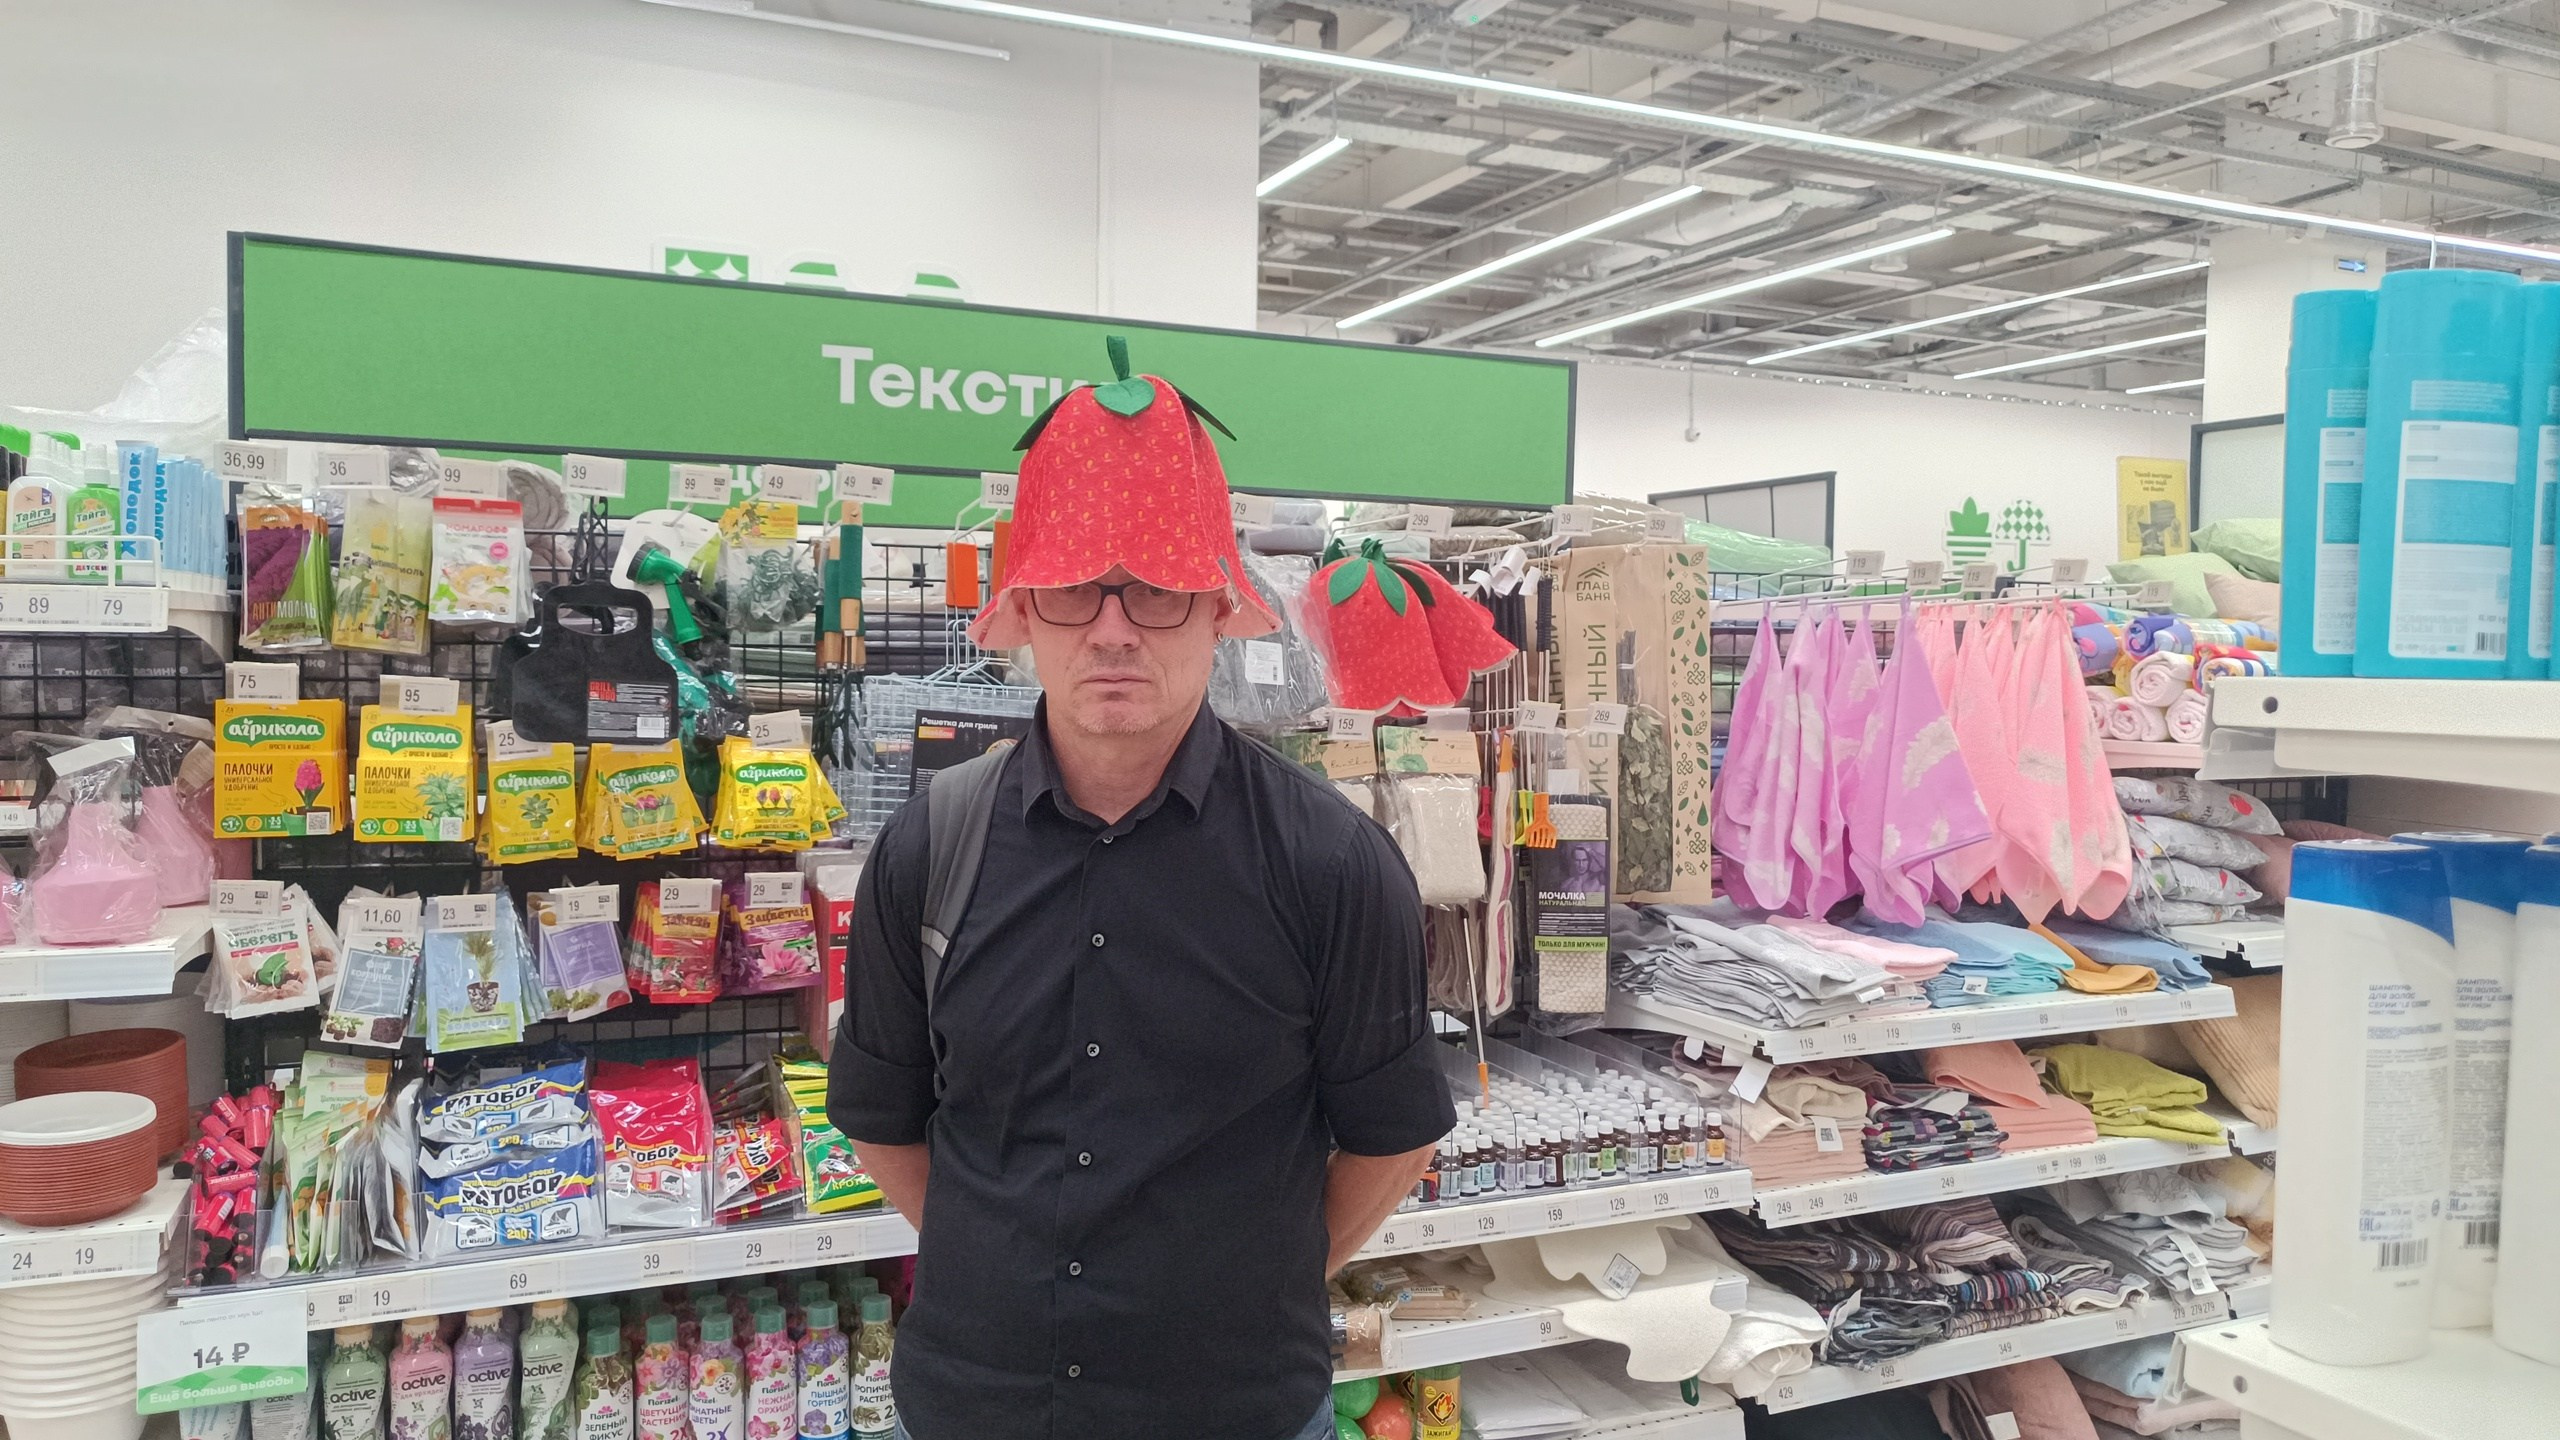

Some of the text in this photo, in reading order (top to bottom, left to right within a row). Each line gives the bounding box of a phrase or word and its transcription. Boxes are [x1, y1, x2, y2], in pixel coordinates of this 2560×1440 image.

[822, 343, 1118, 417] Тексти
[223, 450, 265, 470] 36,99
[329, 461, 347, 475] 36
[571, 464, 587, 480] 39
[444, 467, 461, 483] 99
[844, 475, 856, 488] 49
[684, 478, 696, 490] 99
[768, 476, 784, 489] 49
[989, 483, 1009, 497] 199
[122, 452, 142, 557] ХОЛОДОК
[1234, 502, 1246, 515] 79
[16, 508, 51, 523] Тайга
[76, 509, 107, 523] Тайга
[155, 463, 167, 563] ОЛОДОК
[1561, 513, 1571, 525] 39
[1412, 514, 1429, 526] 299
[1650, 519, 1666, 531] 359
[1852, 558, 1866, 568] 119
[1913, 568, 1926, 580] 119
[1967, 571, 1980, 582] 119
[2058, 566, 2071, 576] 119
[1576, 581, 1610, 591] ГЛАВ
[2147, 587, 2159, 597] 119
[1576, 593, 1610, 601] БАНЯ
[28, 597, 49, 614] 89
[103, 599, 123, 615] 79
[239, 675, 256, 689] 75
[405, 689, 420, 702] 95
[1524, 710, 1536, 721] 79
[1594, 711, 1610, 721] 269
[229, 717, 322, 741] агрикола
[921, 717, 998, 731] Решетка для гриля
[1338, 718, 1354, 730] 159
[371, 725, 458, 748] агрикола
[755, 724, 769, 738] 25
[499, 733, 515, 746] 25
[224, 763, 273, 776] ПАЛОЧКИ
[364, 766, 411, 779] ПАЛОЧКИ
[740, 765, 804, 782] агрикола
[224, 776, 272, 784] УНИВЕРСАЛЬНОЕ
[497, 773, 569, 791] агрикола
[609, 768, 677, 790] агрикола
[364, 787, 396, 795] УДОБРЕНИЕ
[3, 813, 18, 822] 149
[664, 887, 679, 900] 29
[753, 884, 765, 896] 29
[1538, 891, 1586, 900] МОЧАЛКА
[220, 892, 234, 904] 29
[568, 900, 580, 911] 19
[364, 909, 401, 924] 11,60
[443, 908, 456, 920] 23
[2115, 1006, 2128, 1017] 119
[2180, 1000, 2192, 1010] 119
[2039, 1013, 2048, 1025] 89
[1886, 1027, 1900, 1039] 119
[1952, 1022, 1961, 1033] 99
[1800, 1037, 1814, 1049] 119
[1843, 1032, 1857, 1044] 119
[445, 1081, 543, 1113] РАТОБОР
[614, 1136, 679, 1162] РТОБОР
[2069, 1157, 2082, 1168] 199
[2094, 1153, 2107, 1165] 199
[2036, 1163, 2047, 1175] 199
[1941, 1177, 1954, 1189] 249
[462, 1175, 563, 1206] РАТОБОР
[1704, 1186, 1719, 1200] 129
[1610, 1198, 1625, 1211] 129
[1654, 1193, 1669, 1205] 129
[1809, 1196, 1824, 1209] 249
[1844, 1192, 1858, 1205] 249
[1548, 1209, 1563, 1221] 159
[1777, 1202, 1792, 1215] 249
[1478, 1216, 1494, 1230] 129
[1423, 1224, 1434, 1237] 39
[817, 1236, 833, 1252] 29
[1384, 1232, 1394, 1245] 49
[75, 1248, 95, 1265] 19
[746, 1243, 762, 1258] 29
[12, 1253, 33, 1271] 24
[644, 1255, 660, 1270] 39
[510, 1273, 527, 1289] 69
[373, 1291, 390, 1306] 19
[2173, 1308, 2185, 1319] 279
[2191, 1305, 2203, 1316] 279
[2203, 1302, 2215, 1314] 279
[1540, 1322, 1551, 1335] 99
[2115, 1319, 2128, 1330] 169
[2000, 1343, 2012, 1355] 349
[193, 1346, 223, 1368] 14
[467, 1367, 511, 1383] active
[523, 1362, 563, 1377] active
[1881, 1365, 1895, 1378] 499
[401, 1373, 446, 1391] active
[150, 1391, 180, 1404] Ещё
[182, 1384, 237, 1398] больше
[330, 1388, 377, 1404] active
[758, 1391, 795, 1404] НЕЖНАЯ
[811, 1385, 847, 1399] ПЫШНАЯ
[1779, 1386, 1793, 1400] 429
[639, 1402, 688, 1417] ЦВЕТУЩИЕ
[585, 1416, 628, 1432] ЗЕЛЕНЫЙ
[641, 1414, 686, 1426] РАСТЕНИЯ
[589, 1429, 624, 1440] ФИКУС
